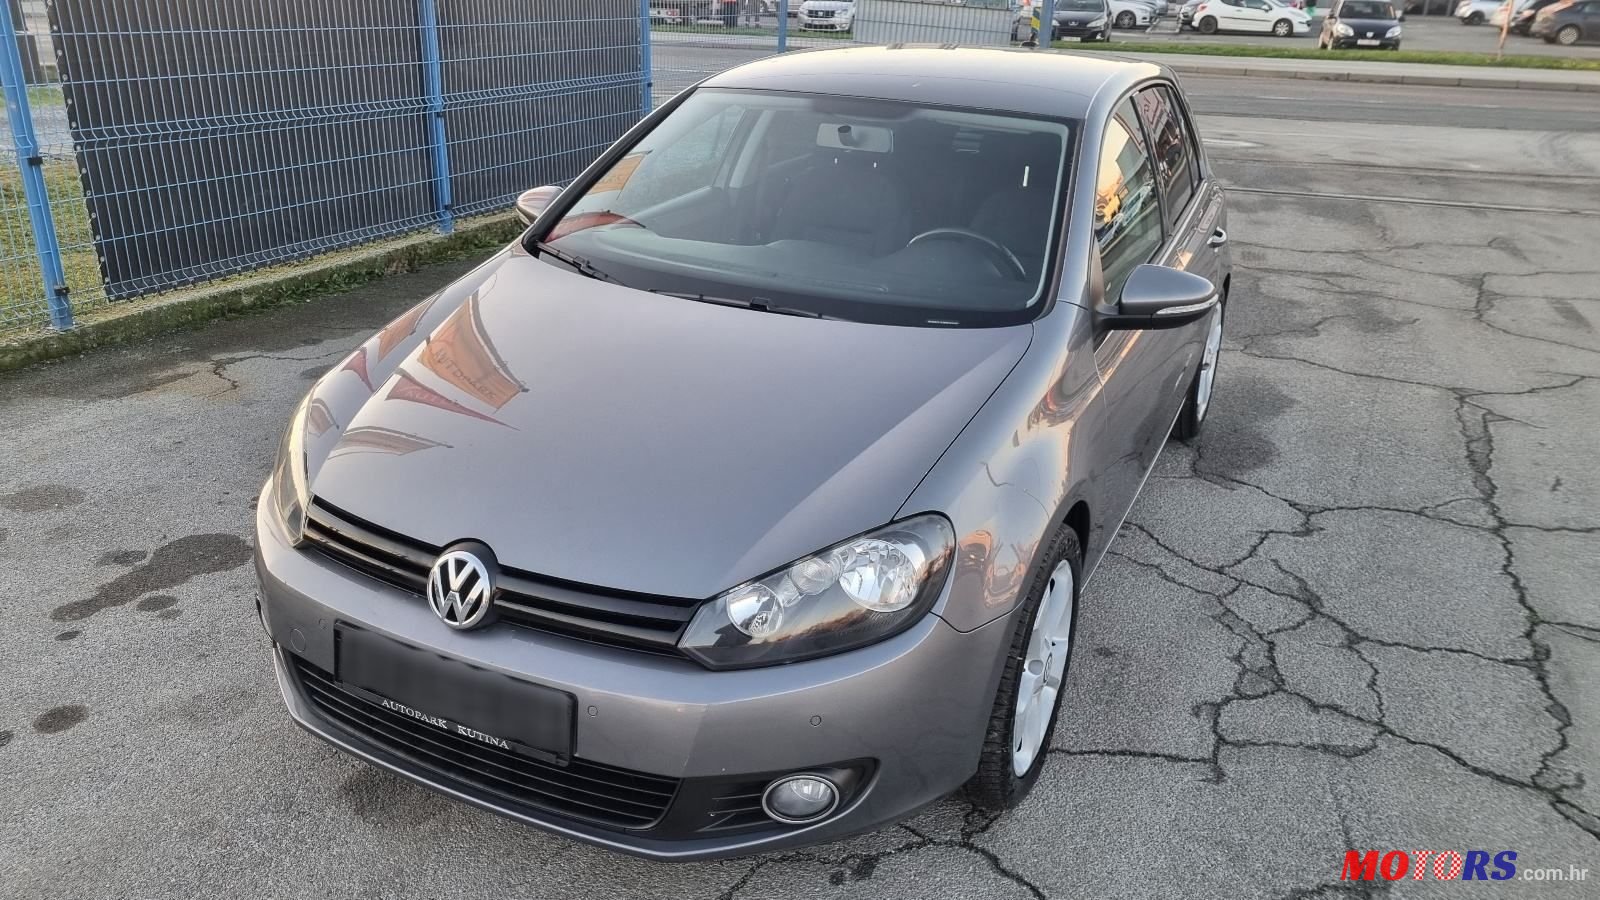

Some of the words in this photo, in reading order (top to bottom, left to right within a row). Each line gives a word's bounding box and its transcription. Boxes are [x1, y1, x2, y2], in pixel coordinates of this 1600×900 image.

[430, 552, 488, 627] VW
[381, 699, 448, 729] AUTOPARK
[457, 724, 510, 750] KUTINA
